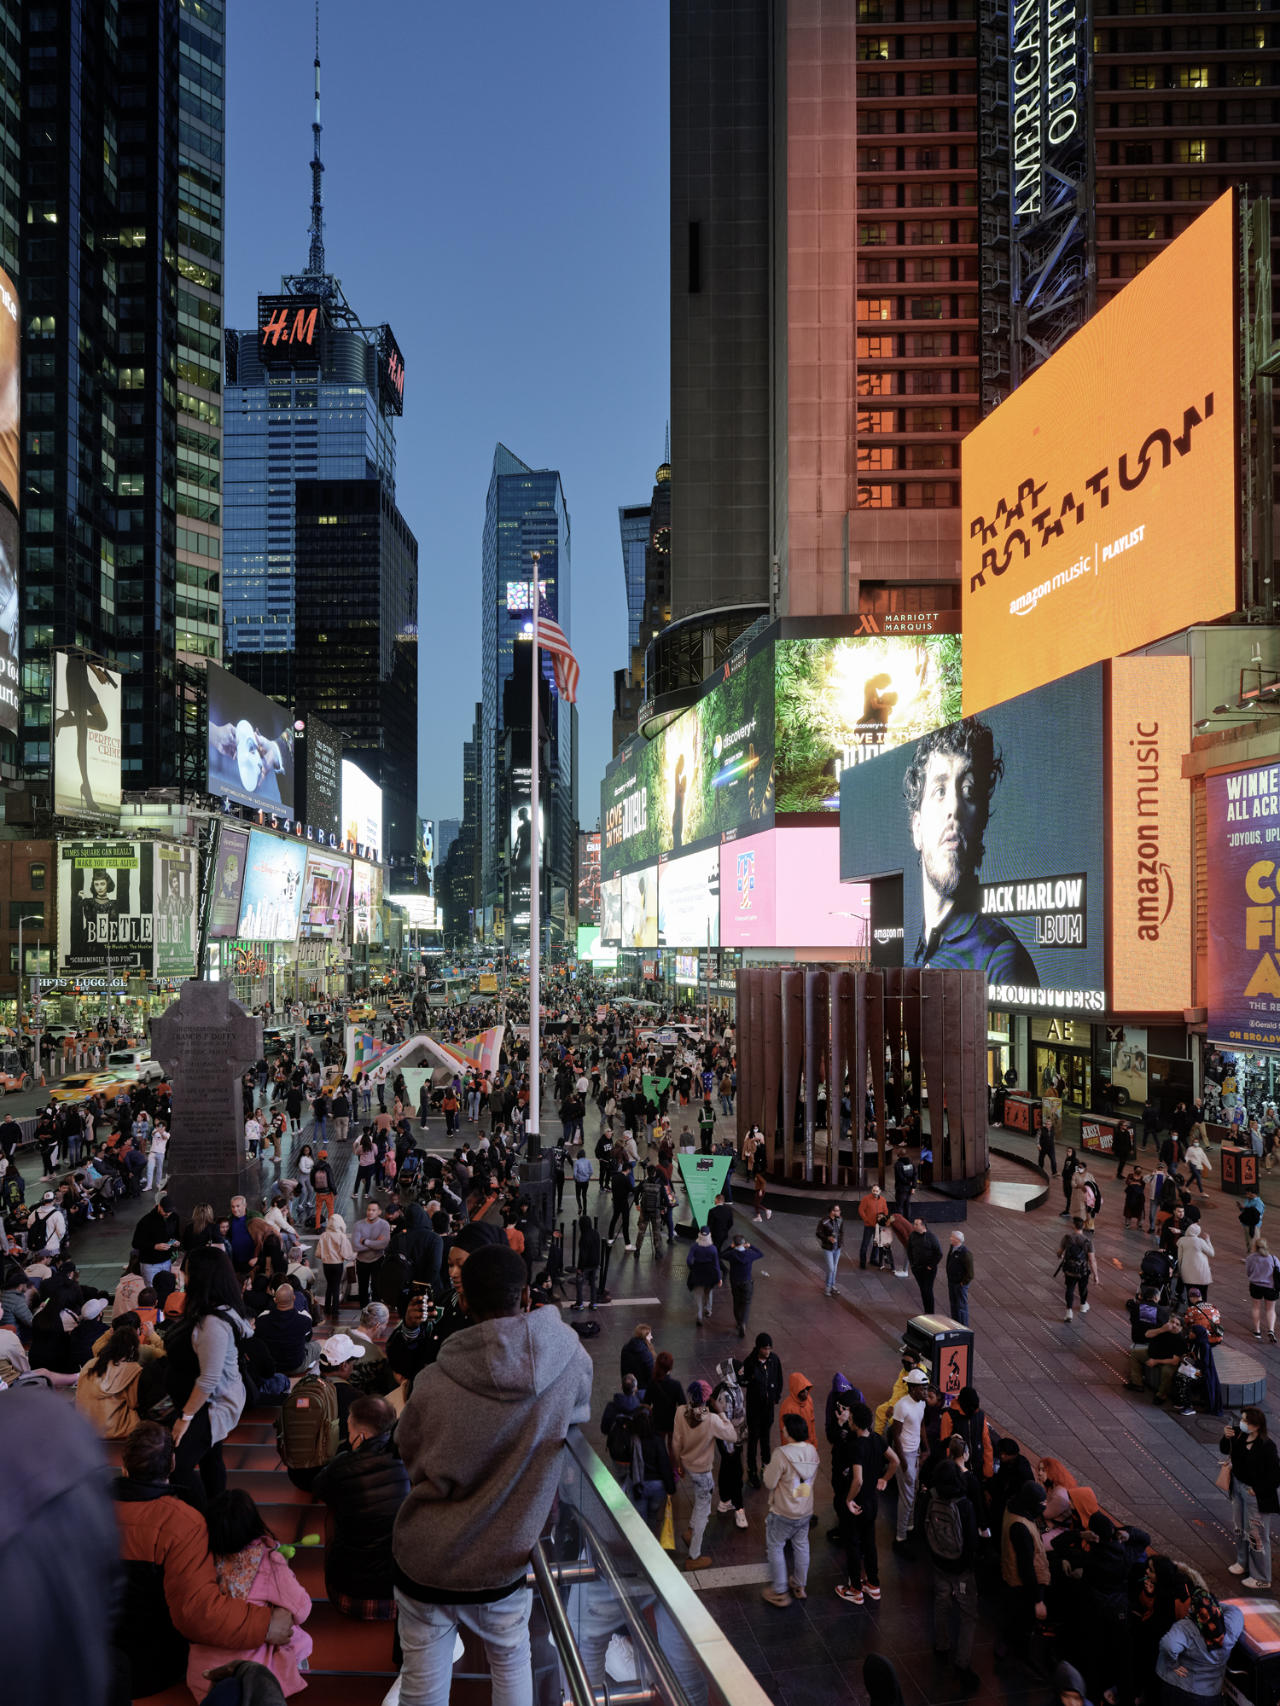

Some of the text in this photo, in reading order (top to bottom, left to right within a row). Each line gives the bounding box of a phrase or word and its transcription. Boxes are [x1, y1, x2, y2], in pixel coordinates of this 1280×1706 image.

[1014, 0, 1041, 215] AMERICAN
[262, 308, 318, 346] H&M
[388, 349, 404, 399] H&M
[970, 392, 1214, 593] ROTATION
[970, 477, 1048, 546] RAP
[1009, 525, 1145, 615] amazon music PLAYLIST
[885, 613, 940, 622] MARRIOTT
[885, 622, 933, 631] MARQUIS
[518, 632, 534, 640] 202
[89, 732, 120, 748] PERFECT
[1227, 768, 1279, 800] WINNE
[606, 802, 622, 832] LOVE
[1227, 796, 1279, 822] ALL ACR
[1129, 721, 1159, 941] amazon music
[81, 848, 100, 857] SQUARE
[102, 848, 112, 856] CAN
[94, 859, 105, 867] YOU
[982, 879, 1083, 914] JACK HARLOW
[88, 915, 152, 942] BEETLE
[874, 929, 896, 939] amazon
[1249, 1001, 1267, 1010] THE
[1047, 1018, 1075, 1041] AE
[1229, 1031, 1241, 1040] ON
[1255, 1020, 1277, 1029] Gerald
